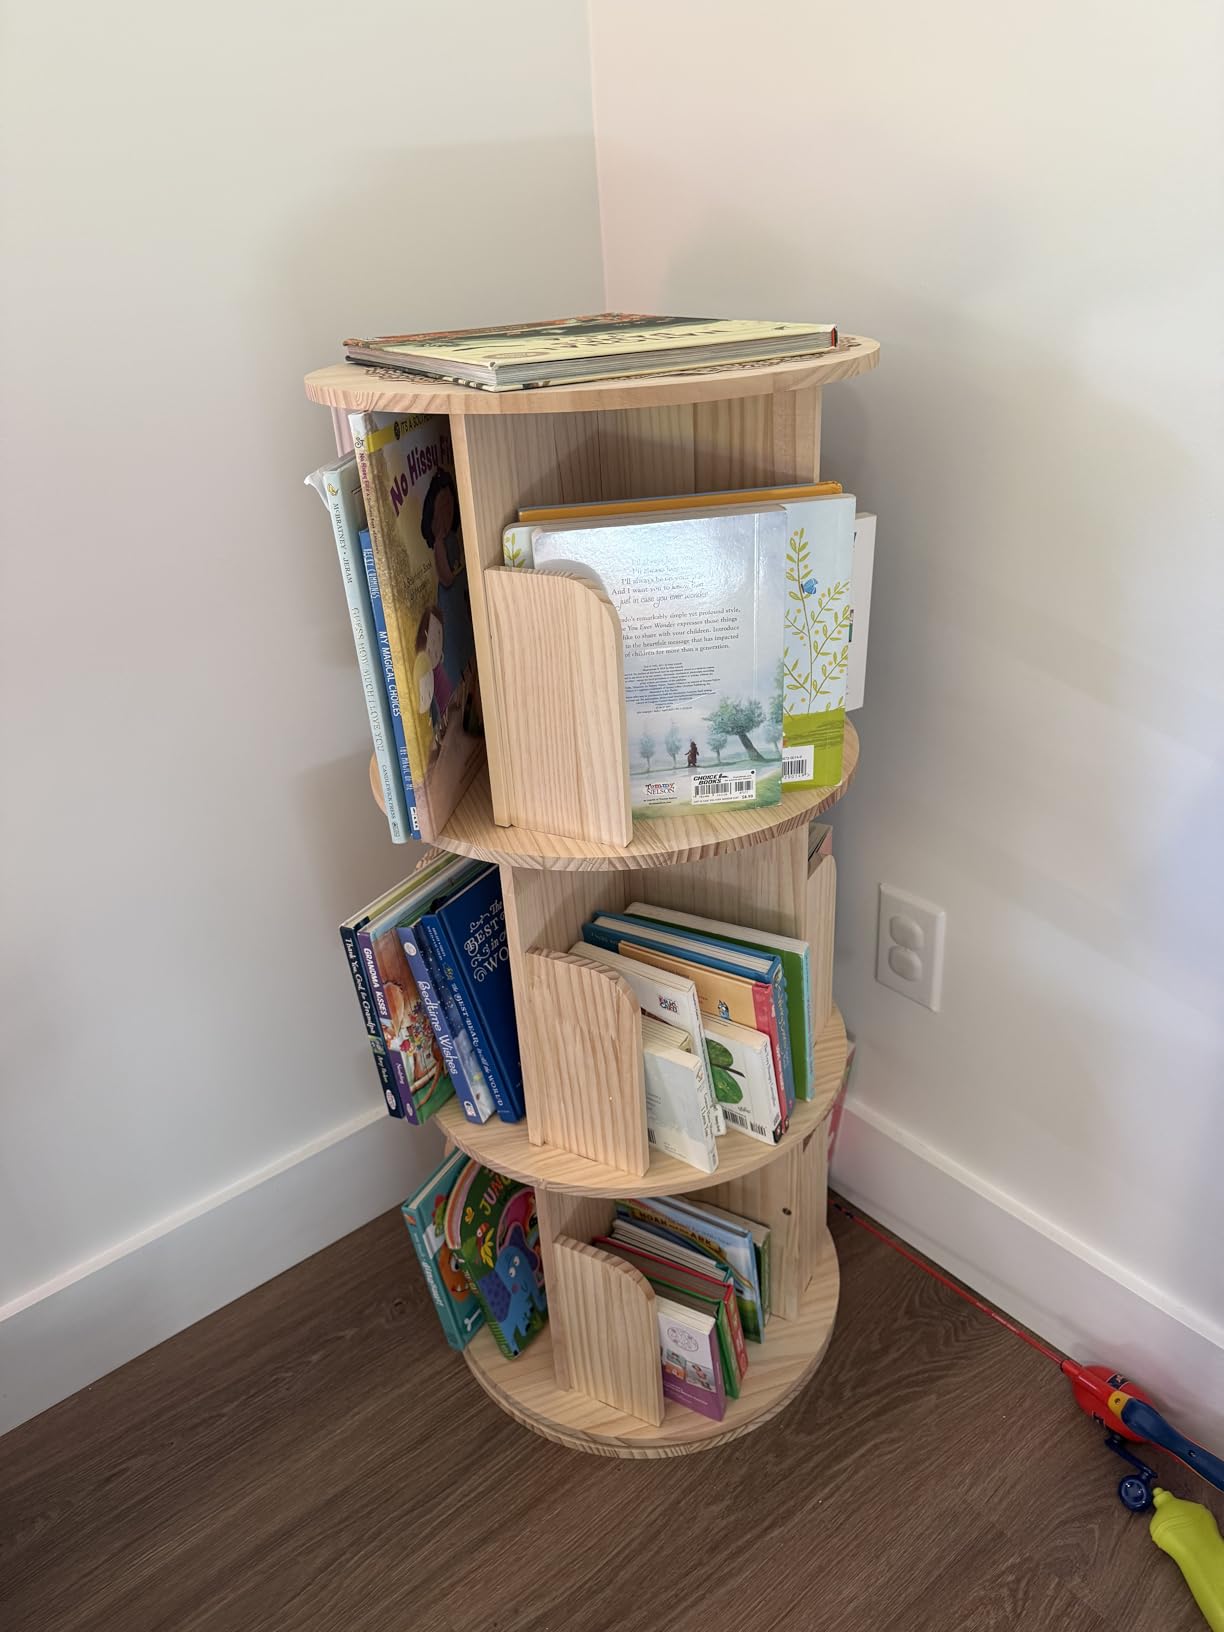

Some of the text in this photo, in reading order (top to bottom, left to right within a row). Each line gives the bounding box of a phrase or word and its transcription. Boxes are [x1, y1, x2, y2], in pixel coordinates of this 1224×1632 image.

[358, 452, 365, 460] No
[390, 475, 409, 518] No
[343, 556, 353, 584] JERAM
[611, 587, 625, 595] And
[655, 594, 668, 608] you
[351, 607, 364, 640] GUESS
[636, 613, 667, 623] remarkably
[669, 611, 686, 620] simple
[699, 607, 724, 617] profound
[654, 620, 675, 628] Wonder
[676, 619, 702, 628] expresses
[720, 614, 737, 624] things
[686, 626, 711, 634] children.
[712, 623, 739, 632] Introduce
[667, 638, 689, 646] message
[714, 632, 739, 641] impacted
[357, 642, 368, 666] HOW
[631, 648, 654, 657] children
[699, 643, 729, 652] generation.
[363, 670, 375, 697] MUCH
[378, 630, 401, 717] MY MAGICAL CHOICES
[369, 705, 381, 730] LOVE
[374, 732, 385, 752] YOU
[693, 773, 717, 781] CHOICE
[646, 786, 675, 795] NELSON
[464, 918, 499, 956] BEST
[491, 938, 499, 951] in
[363, 947, 381, 988] GRANDMA
[344, 937, 356, 958] Thank
[362, 1000, 376, 1034] Grandpa
[417, 979, 442, 1032] Bedtime
[438, 1034, 458, 1075] Wishes
[453, 992, 468, 1017] BEST
[465, 1018, 479, 1045] BEAR
[487, 1074, 504, 1107] WORLD
[689, 1231, 713, 1246] ARK
